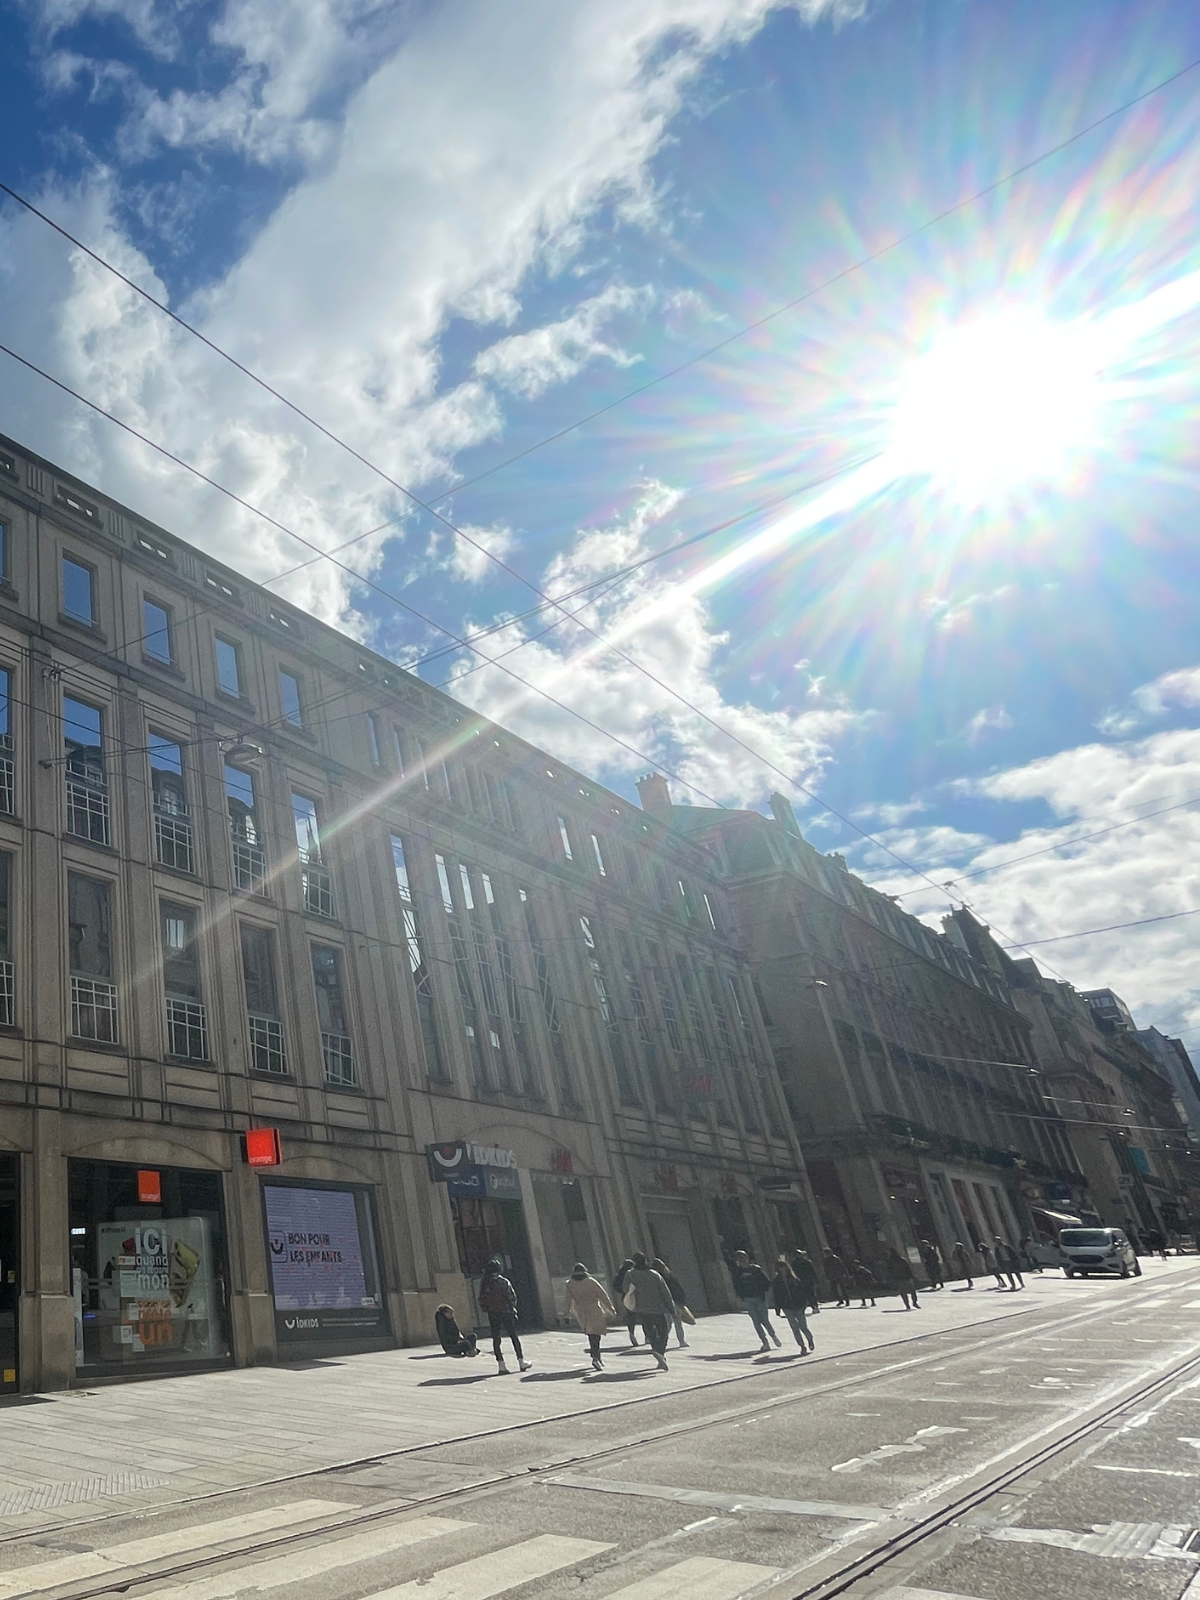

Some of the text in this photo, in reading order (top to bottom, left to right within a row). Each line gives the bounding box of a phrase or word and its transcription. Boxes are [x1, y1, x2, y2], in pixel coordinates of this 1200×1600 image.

[249, 1155, 273, 1164] orange
[289, 1233, 330, 1245] BON POUR
[136, 1254, 169, 1267] quand
[290, 1251, 342, 1263] LES ENFANTS
[138, 1274, 169, 1290] mon
[139, 1321, 174, 1345] un
